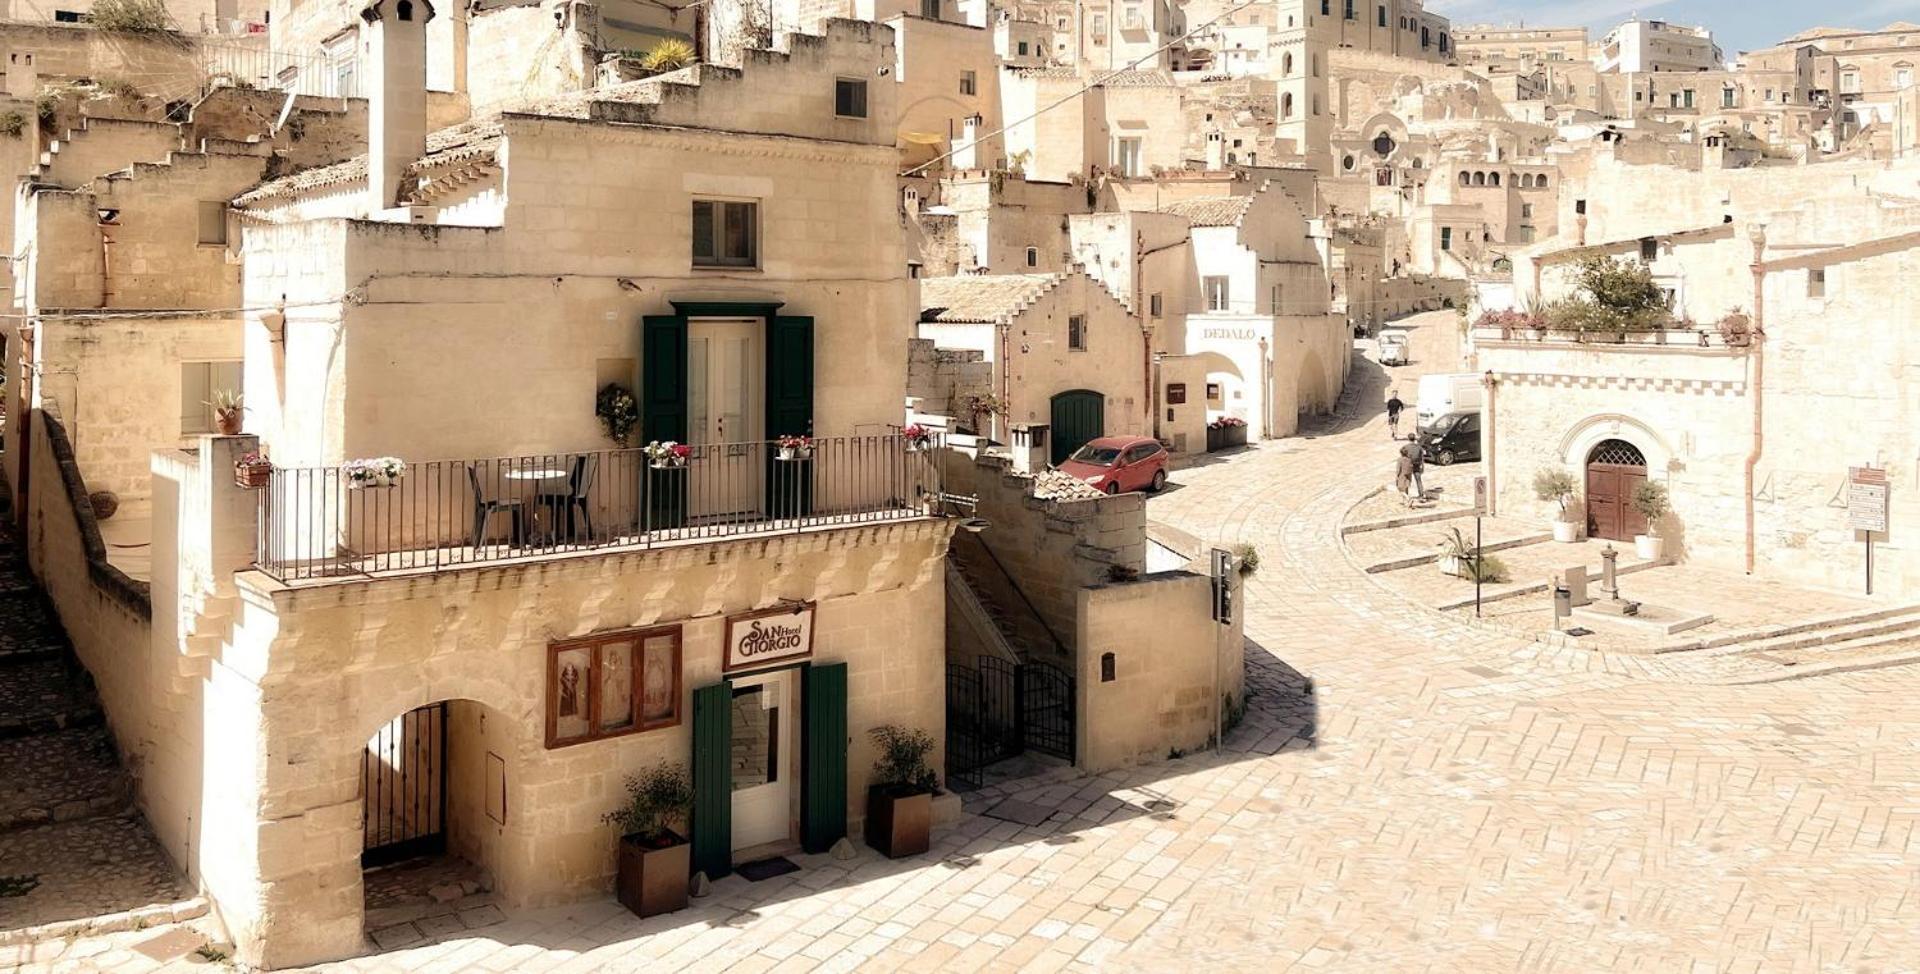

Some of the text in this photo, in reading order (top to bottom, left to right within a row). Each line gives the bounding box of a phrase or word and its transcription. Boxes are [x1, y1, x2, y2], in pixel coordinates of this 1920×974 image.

[1203, 328, 1256, 340] DEDALO
[748, 621, 782, 641] SAN
[739, 634, 801, 657] GIORGIO
